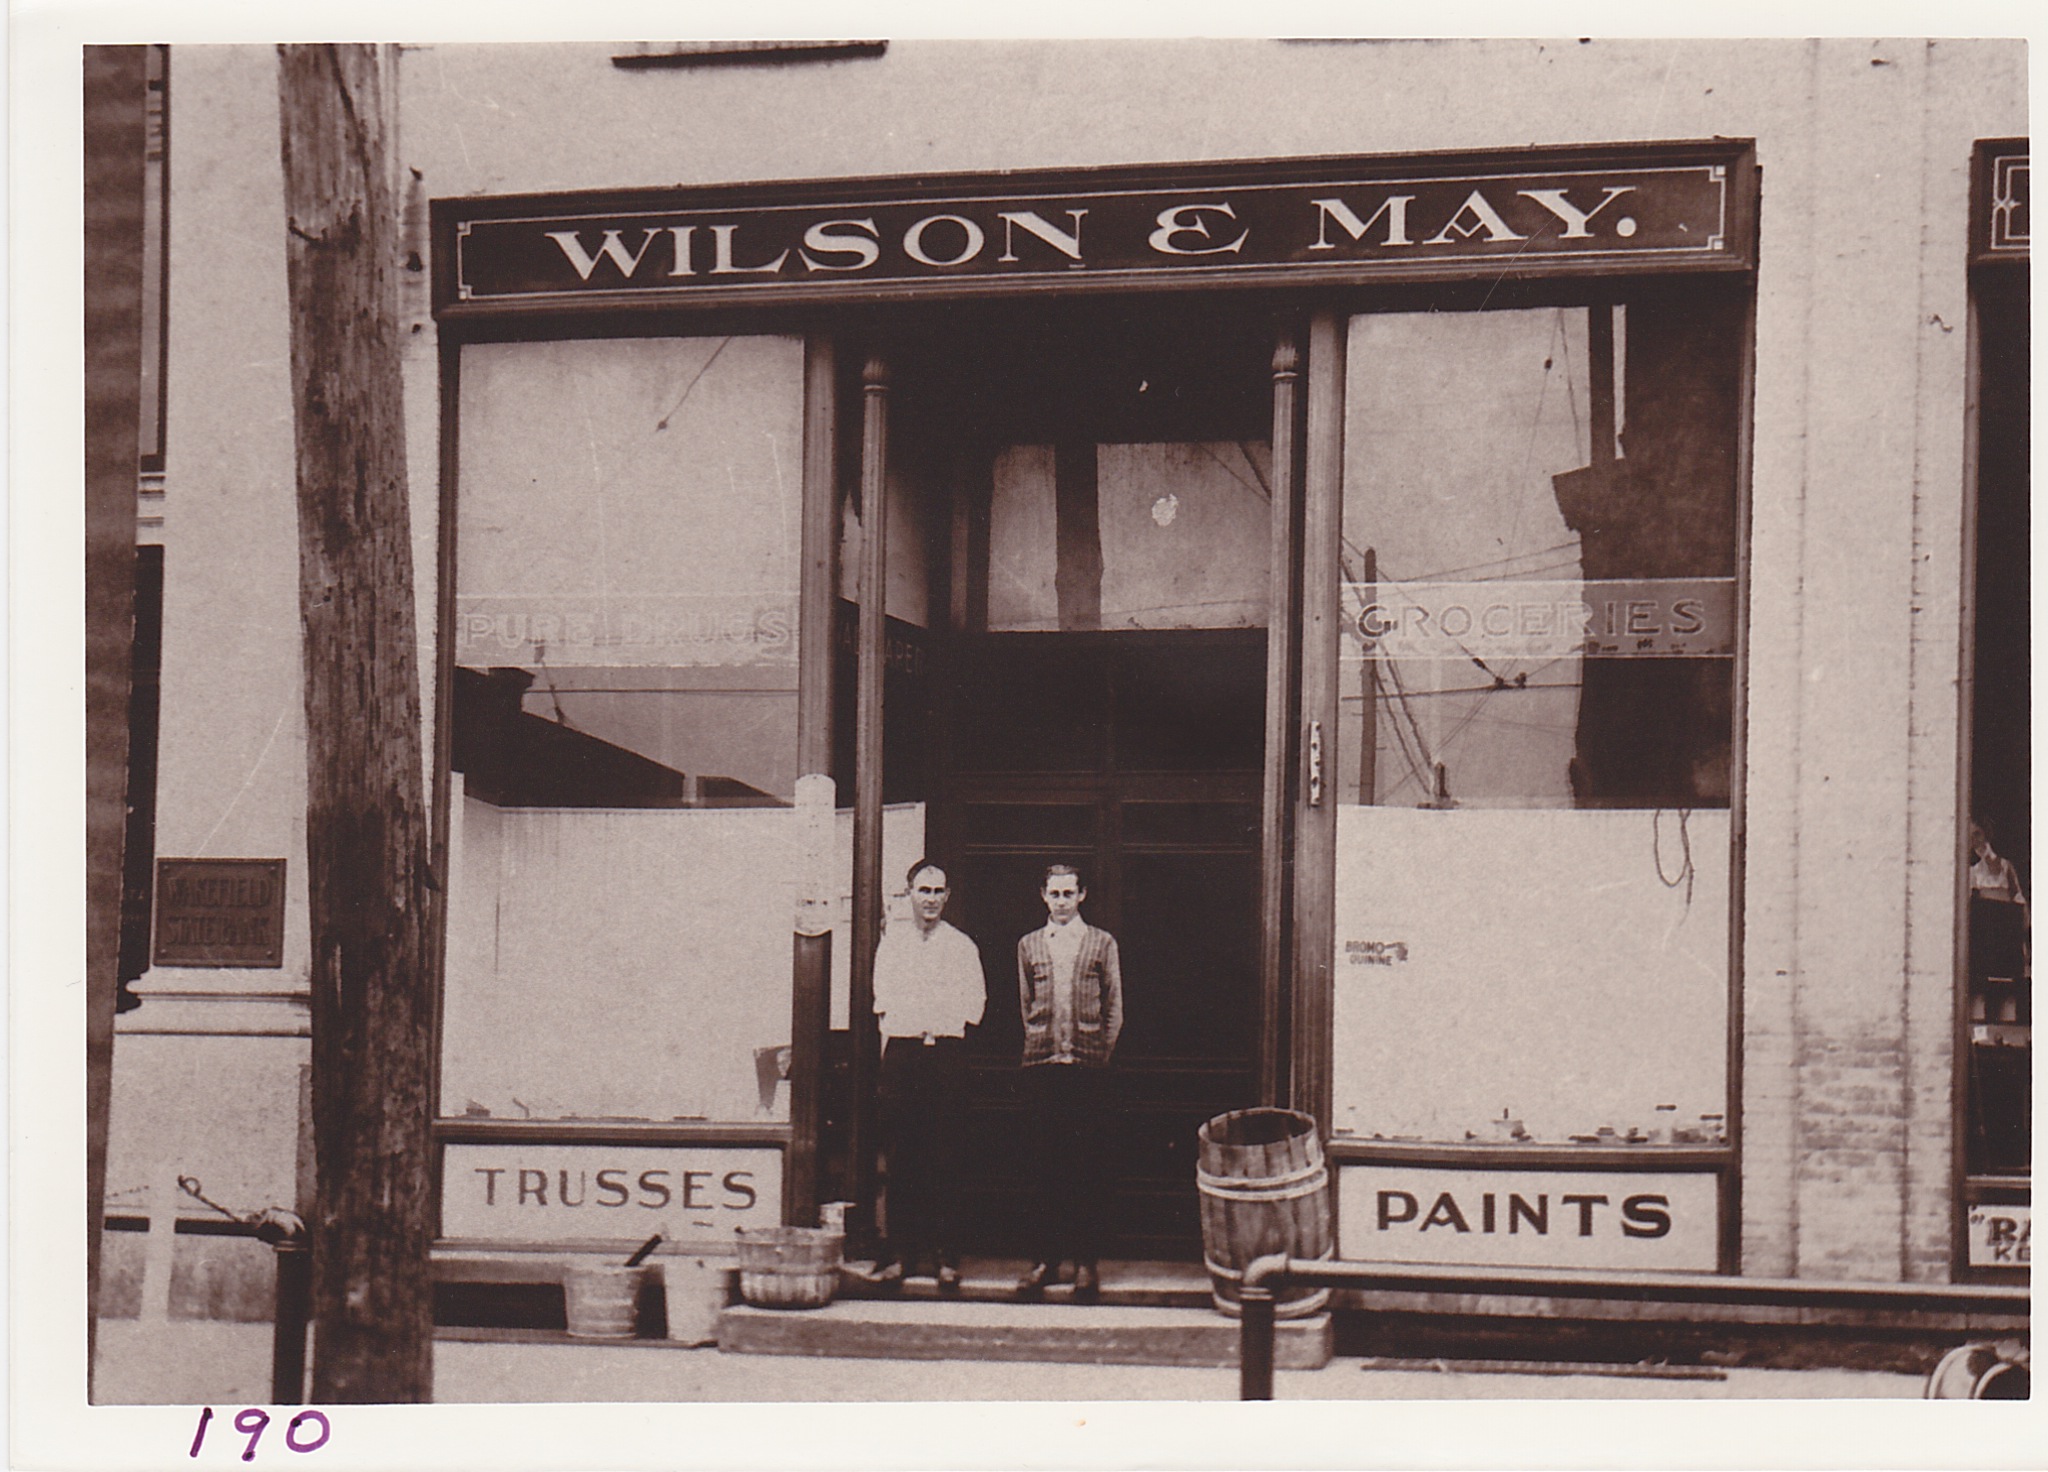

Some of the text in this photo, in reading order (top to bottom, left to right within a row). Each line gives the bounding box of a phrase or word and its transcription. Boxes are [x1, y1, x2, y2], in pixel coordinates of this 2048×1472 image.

[545, 186, 1637, 280] WILSON & MAY.
[1357, 600, 1706, 637] GROCERIES
[474, 1168, 757, 1211] TRUSSES
[1376, 1189, 1673, 1239] PAINTS
[189, 1407, 331, 1462] 190
